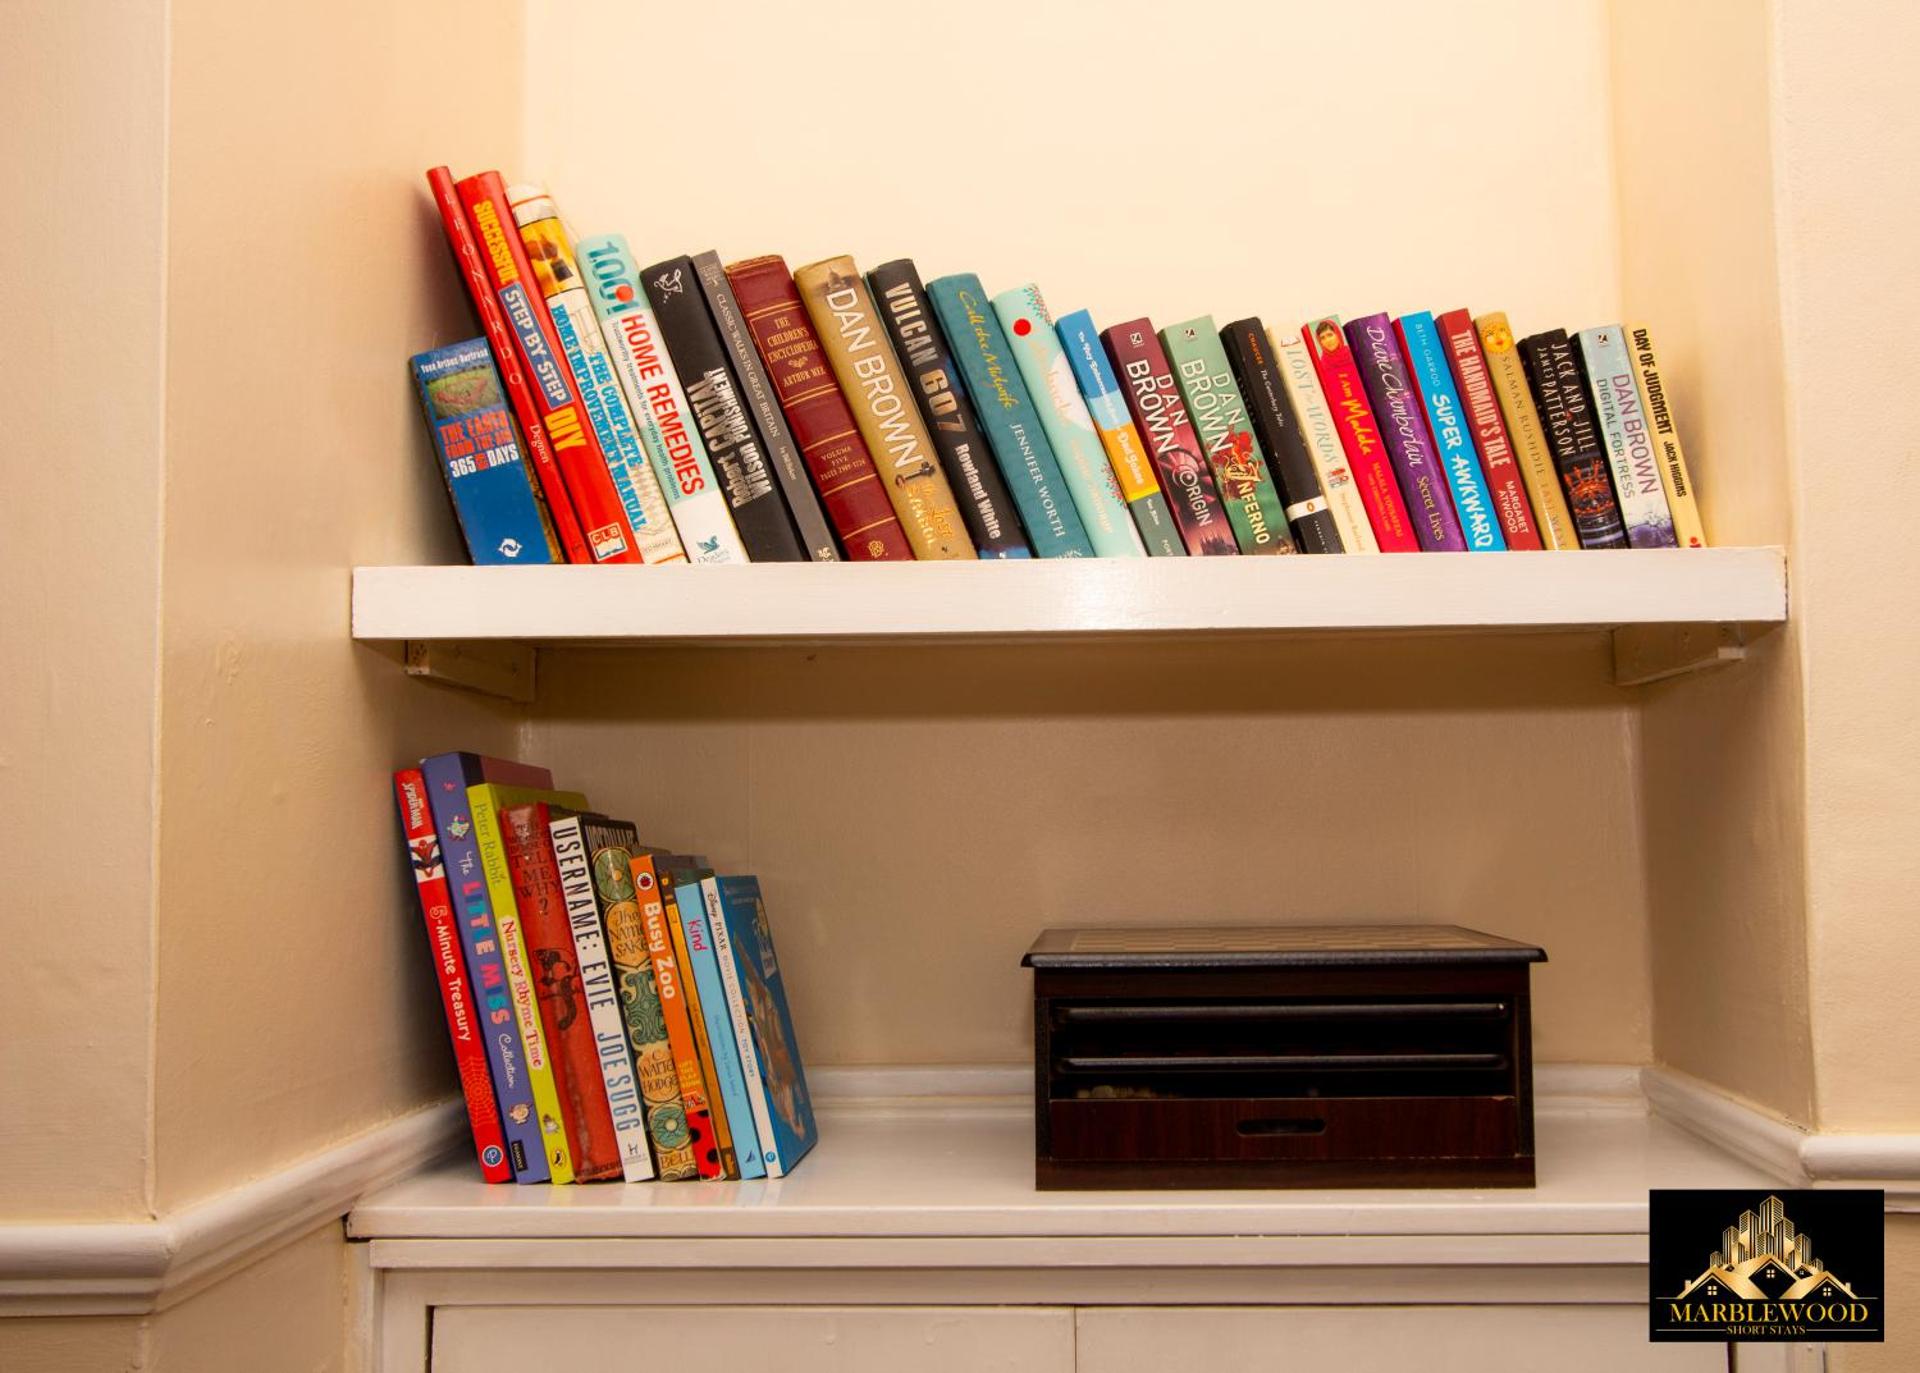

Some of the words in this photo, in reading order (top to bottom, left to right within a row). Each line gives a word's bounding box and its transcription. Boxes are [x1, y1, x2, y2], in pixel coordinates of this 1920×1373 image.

[473, 200, 519, 285] SUCCESSFUL
[716, 293, 737, 333] CLASSIC
[767, 326, 810, 348] CHILDREN'S
[774, 316, 791, 330] THE
[959, 290, 985, 326] Call
[975, 327, 992, 350] the
[1415, 322, 1428, 346] BETH
[1632, 328, 1650, 350] DAY
[505, 290, 533, 330] STEP
[525, 332, 547, 356] BY
[537, 361, 566, 401] STEP
[732, 330, 747, 361] WALKS
[742, 359, 754, 372] IN
[885, 282, 938, 367] VULCAN
[920, 369, 967, 433] 607
[1451, 329, 1477, 357] THE
[1537, 347, 1555, 379] JAMES
[1551, 342, 1577, 379] JACK
[1639, 351, 1656, 368] OF
[747, 370, 766, 402] GREAT
[826, 288, 877, 353] DAN
[854, 354, 924, 468] BROWN
[1156, 373, 1189, 427] DAN
[1211, 372, 1246, 426] DAN
[1260, 369, 1268, 380] The
[1367, 325, 1393, 372] Diane
[1382, 373, 1425, 468] Chamberlain
[1459, 354, 1501, 437] HANDMAID'S
[1563, 383, 1586, 414] AND
[1612, 373, 1637, 417] DAN
[1643, 367, 1673, 436] JUDGMENT
[543, 407, 587, 451] DIY
[551, 304, 579, 350] HOME
[567, 348, 623, 463] IMPROVEMENT
[611, 463, 647, 532] MANUAL
[588, 352, 612, 384] THE
[601, 385, 643, 468] COMPLETE
[621, 314, 664, 380] HOME
[646, 383, 705, 496] REMEDIES
[759, 401, 780, 438] BRITAIN
[1126, 359, 1180, 454] BROWN
[1180, 359, 1234, 454] BROWN
[1287, 350, 1314, 390] LOST
[1306, 400, 1340, 463] WORDS
[1340, 400, 1373, 456] Malala
[1501, 355, 1525, 409] SALMAN
[1519, 414, 1546, 475] RUSHDIE
[1541, 380, 1577, 458] PATTERSON
[450, 455, 477, 478] 365
[486, 443, 519, 468] DAYS
[645, 413, 659, 443] everyday
[656, 443, 669, 466] health
[664, 466, 680, 500] problems
[1117, 431, 1131, 456] Dad
[1125, 454, 1144, 485] Jokes
[1482, 433, 1512, 469] TALE
[1573, 420, 1597, 452] JILL
[1596, 378, 1611, 429] DIGITAL
[1609, 431, 1636, 499] FORTRESS
[1623, 418, 1660, 495] BROWN
[717, 452, 752, 509] Robert
[739, 442, 772, 500] Wilson
[955, 443, 988, 500] Rowland
[977, 499, 1001, 539] White
[1010, 423, 1045, 486] JENNIFER
[1038, 485, 1066, 538] WORTH
[1180, 468, 1214, 527] ORIGIN
[1432, 394, 1463, 450] SUPER
[1451, 453, 1494, 548] AWKWARD
[1663, 440, 1677, 464] JACK
[1670, 463, 1687, 498] HIGGINS
[1230, 460, 1270, 545] INFERNO
[1416, 475, 1436, 511] Secret
[1429, 512, 1445, 541] Lives
[1498, 489, 1519, 534] ATWOOD
[1505, 479, 1529, 534] MARGARET
[591, 527, 620, 544] CLB
[459, 851, 475, 875] The
[475, 803, 489, 845] Peter
[483, 842, 503, 885] Rabbit
[463, 882, 496, 956] LITTLE
[553, 826, 601, 950] USERNAME:
[582, 961, 616, 1011] EVIE
[687, 918, 709, 952] Kind
[715, 922, 727, 951] PIXAR
[430, 906, 456, 975] 5-Minute
[448, 976, 471, 1041] Treasury
[644, 903, 666, 952] Busy
[656, 956, 676, 1000] Zoo
[480, 963, 512, 1025] MISS
[502, 920, 522, 976] Nursery
[514, 980, 534, 1029] Rhyme
[525, 1032, 543, 1068] Time
[499, 1032, 516, 1089] Collection
[597, 1033, 628, 1071] JOE
[606, 1075, 641, 1132] SUGG
